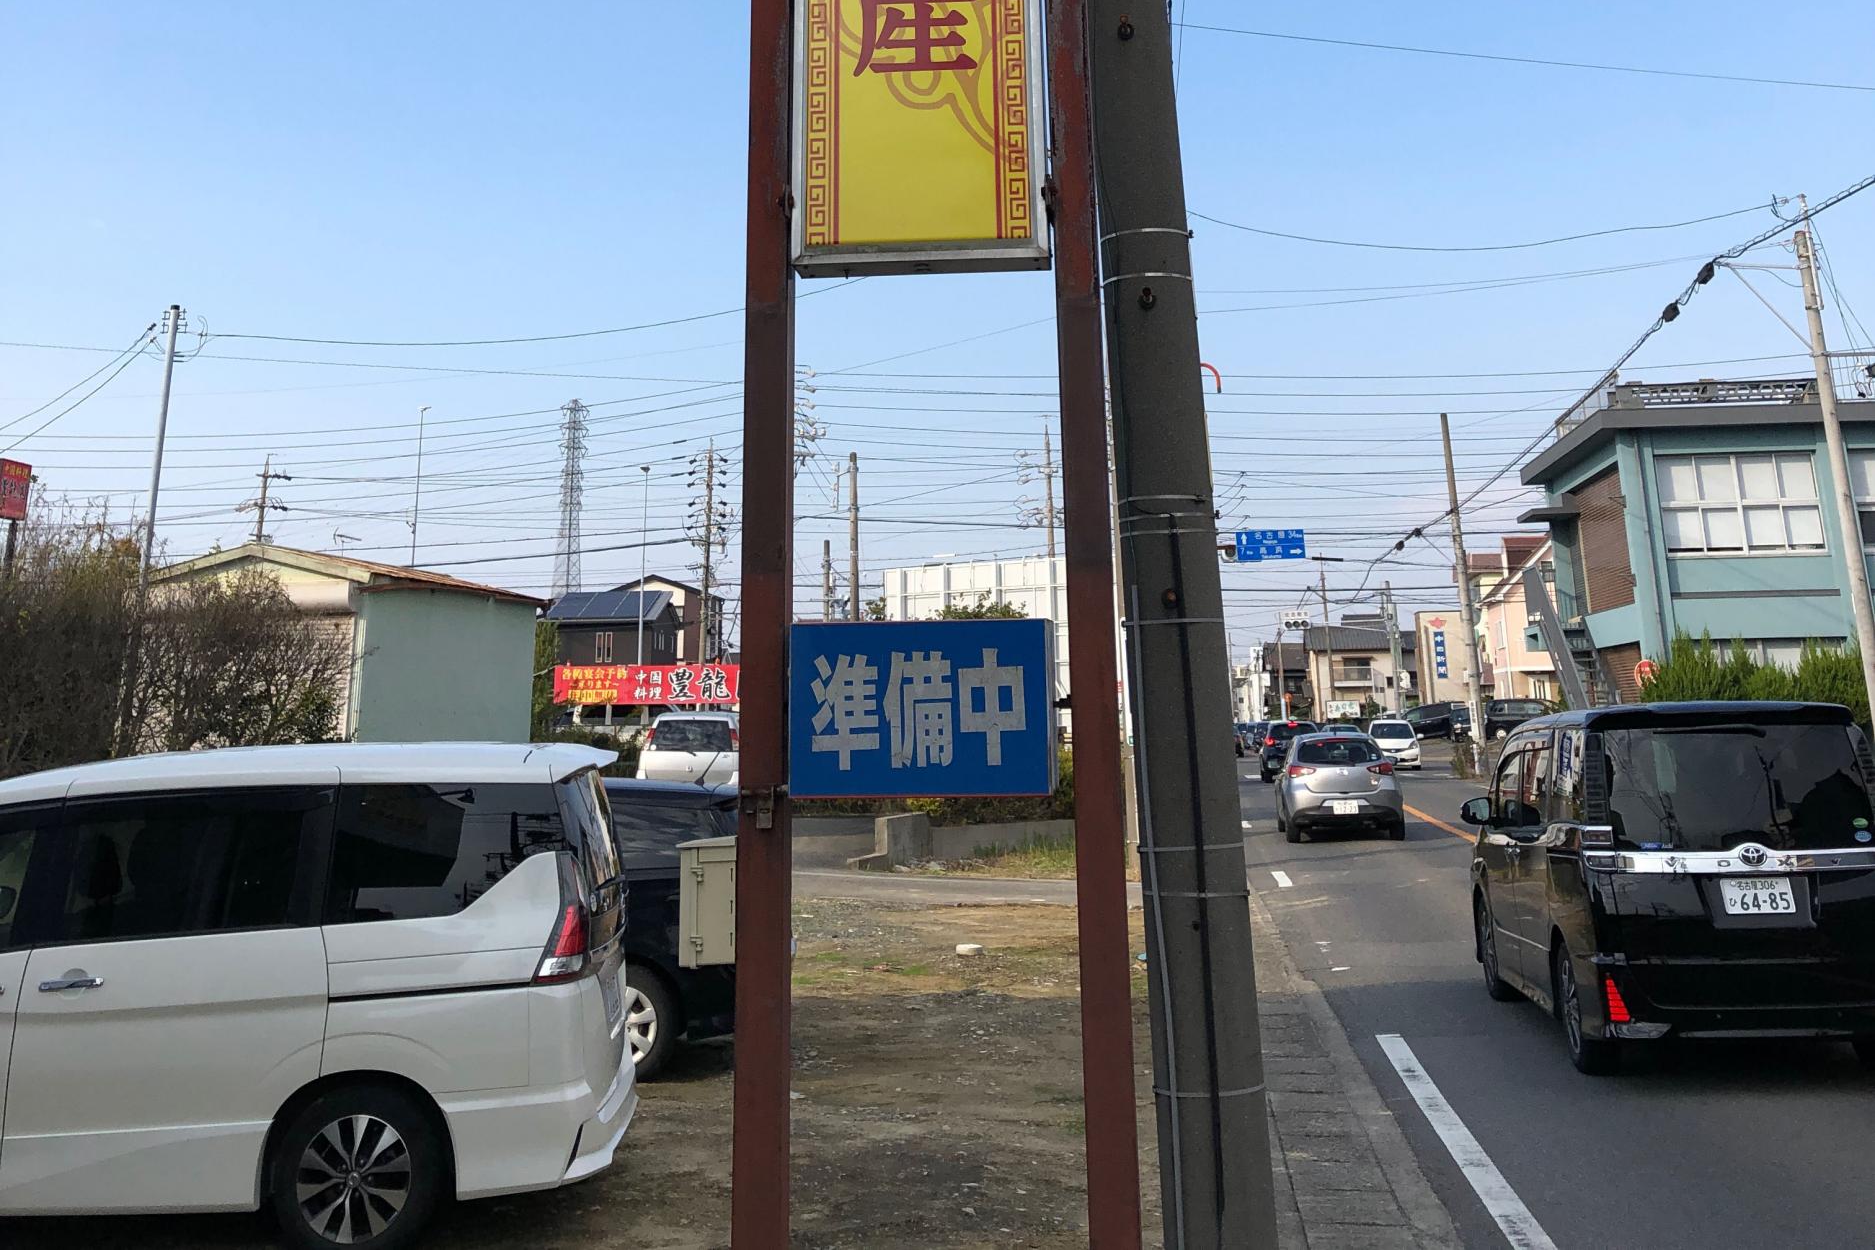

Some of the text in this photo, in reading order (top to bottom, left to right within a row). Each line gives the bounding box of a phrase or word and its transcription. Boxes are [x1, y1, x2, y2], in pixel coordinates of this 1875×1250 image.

[635, 669, 662, 685] 中国
[668, 667, 740, 701] 豊龍
[633, 686, 662, 701] 料理
[810, 648, 1026, 771] 準備中
[1740, 892, 1791, 911] 64-85
